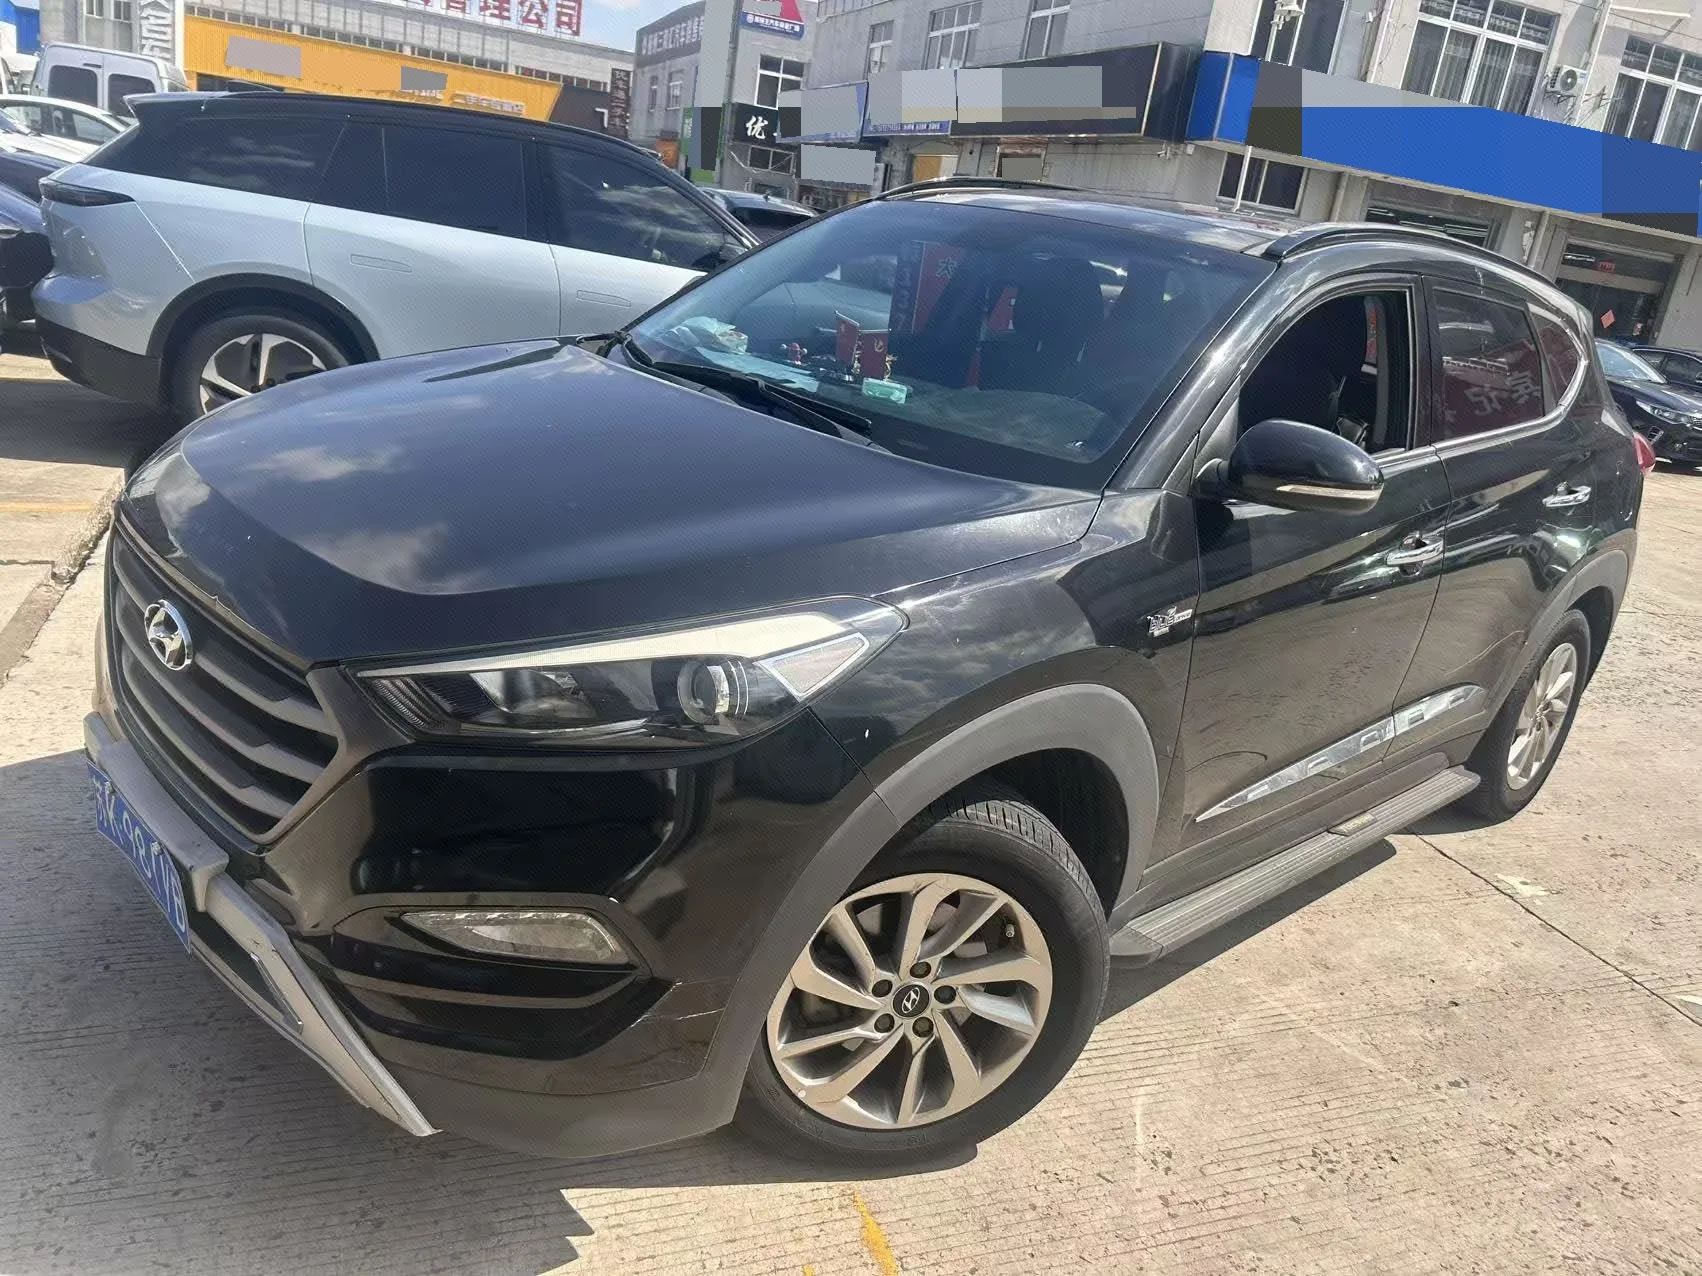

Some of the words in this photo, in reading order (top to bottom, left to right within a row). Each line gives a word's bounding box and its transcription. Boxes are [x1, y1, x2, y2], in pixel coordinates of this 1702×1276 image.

[423, 0, 581, 36] 理公司
[745, 116, 777, 140] 优
